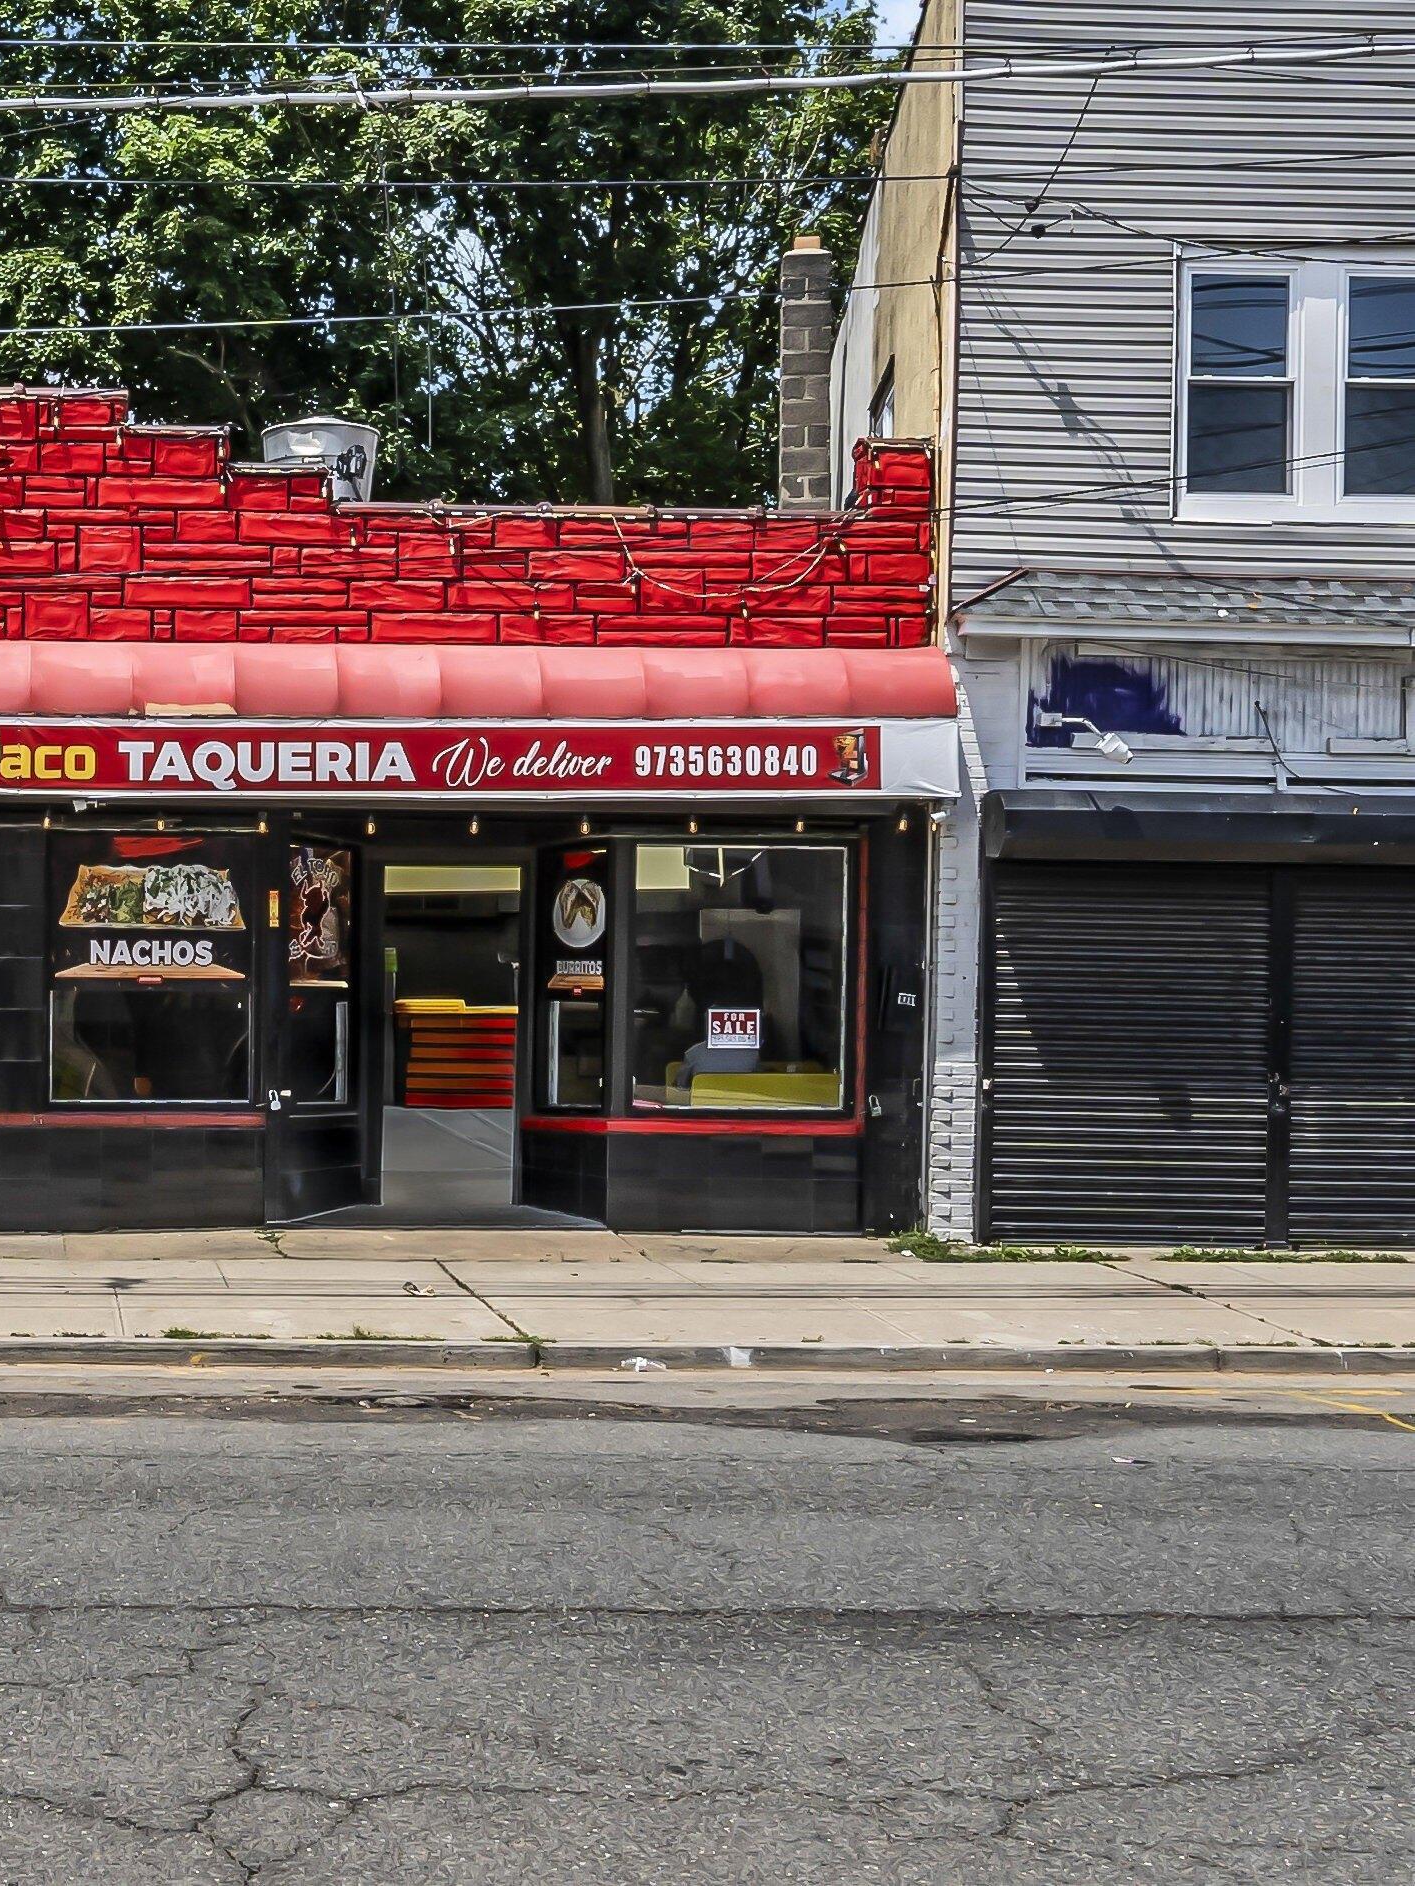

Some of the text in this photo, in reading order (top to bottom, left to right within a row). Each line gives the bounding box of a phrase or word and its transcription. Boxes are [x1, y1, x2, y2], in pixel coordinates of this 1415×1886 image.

[118, 741, 416, 790] TAQUERIA
[431, 736, 612, 787] We deliver
[634, 744, 818, 777] 9735630840
[89, 939, 214, 966] NACHOS
[556, 960, 603, 975] BURRITOS
[712, 1020, 755, 1034] SALE
[723, 1012, 745, 1021] FOR
